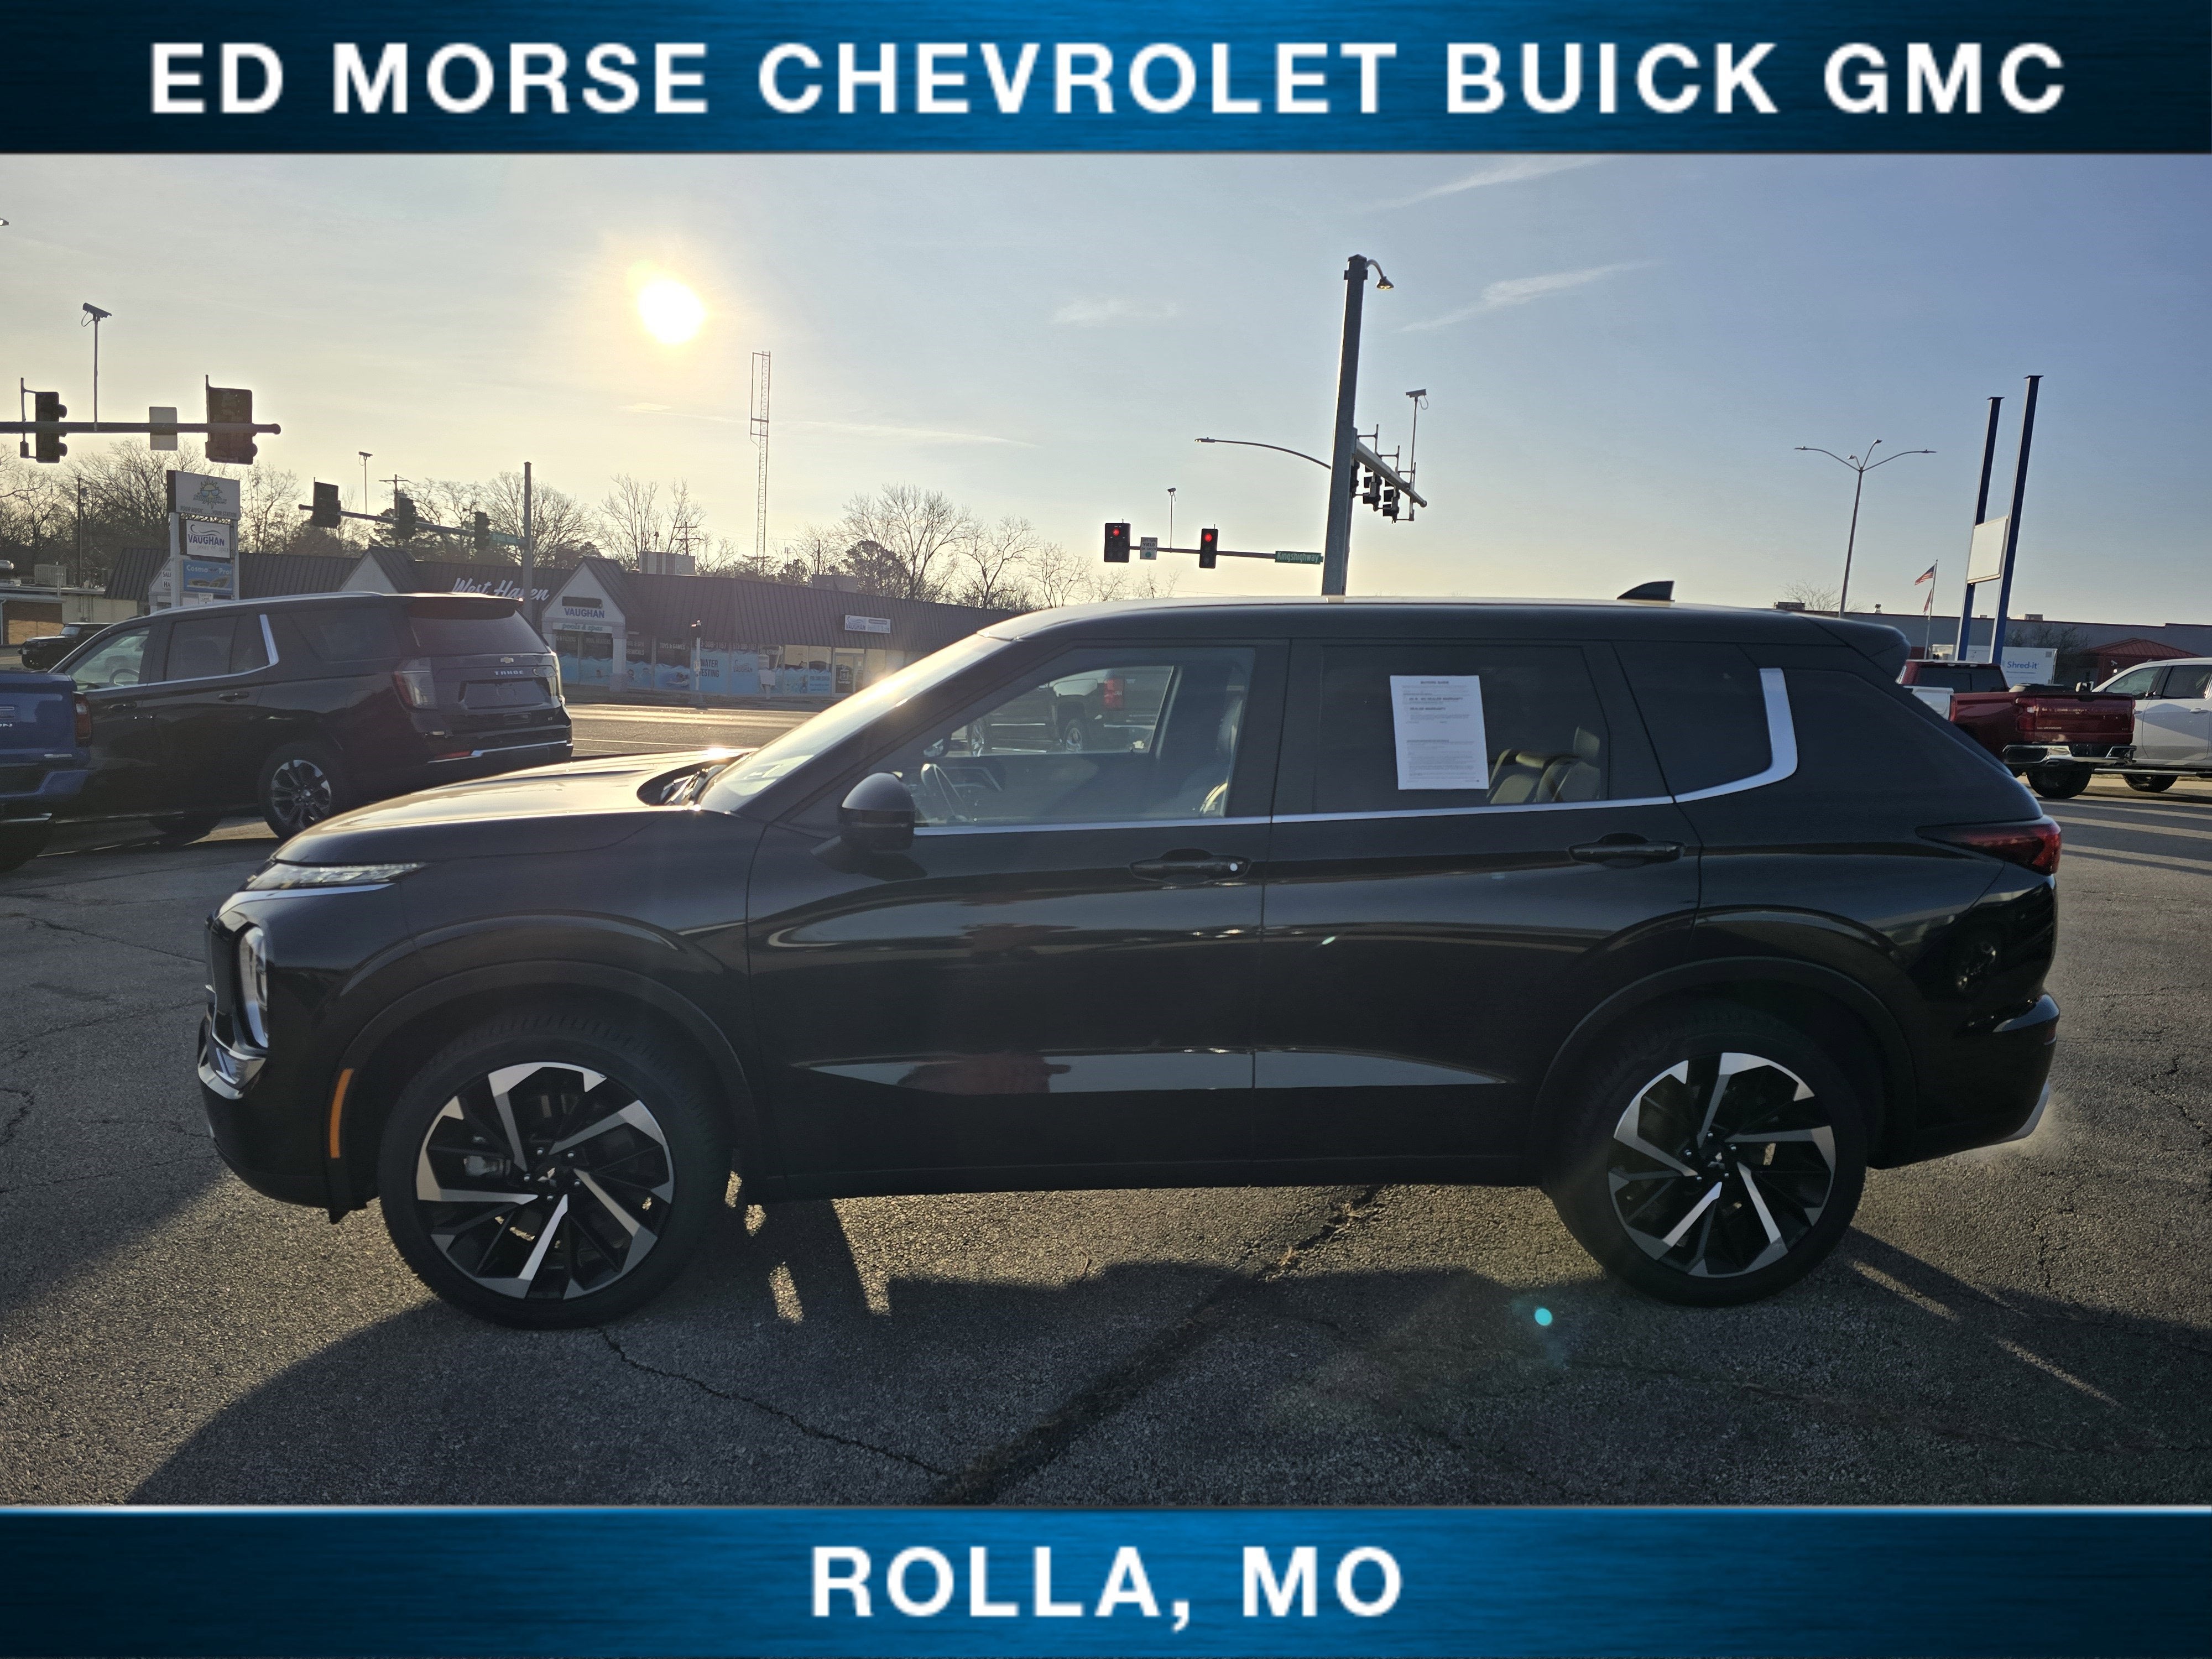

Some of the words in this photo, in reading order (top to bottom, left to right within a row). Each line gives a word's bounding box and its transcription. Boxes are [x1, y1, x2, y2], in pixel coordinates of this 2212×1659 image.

[188, 534, 225, 546] VAUGHAN
[1276, 552, 1319, 564] Kingshighway
[186, 565, 208, 573] Cosmo
[452, 577, 492, 594] West
[564, 608, 605, 618] VAUGHAN
[700, 659, 718, 668] WATER
[2007, 661, 2037, 669] Shred-it
[699, 669, 719, 678] TESTING
